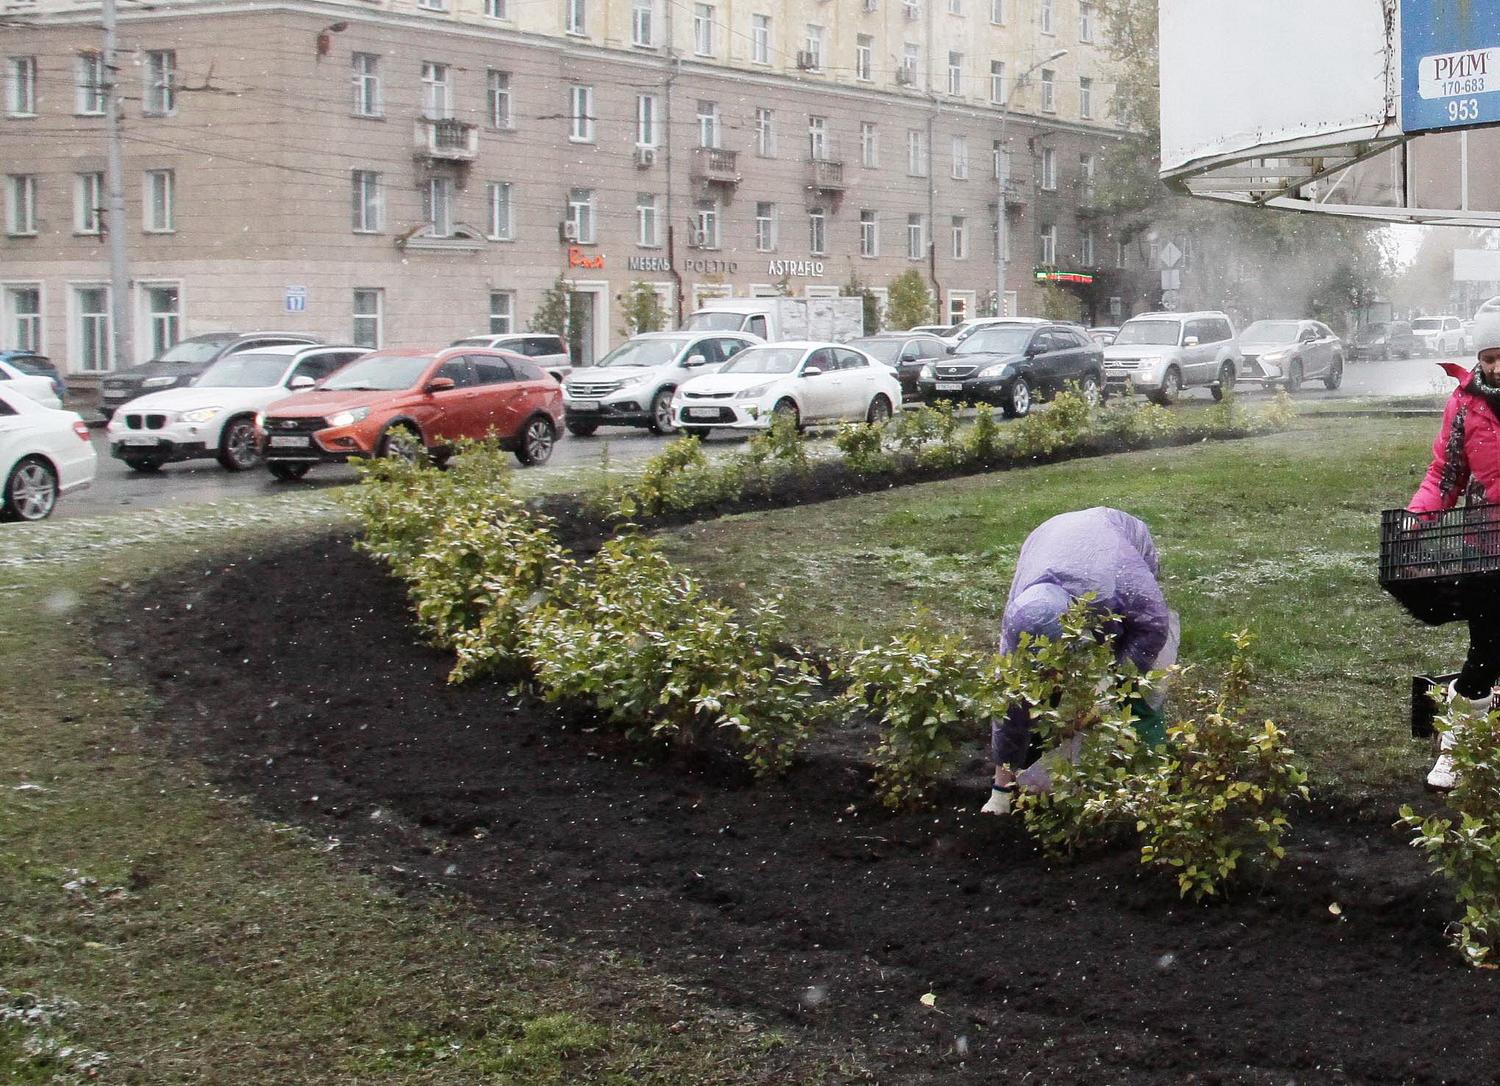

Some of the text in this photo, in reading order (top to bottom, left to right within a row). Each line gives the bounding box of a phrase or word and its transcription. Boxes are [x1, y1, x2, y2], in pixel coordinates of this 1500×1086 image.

[1442, 78, 1485, 95] 170-683
[1448, 98, 1479, 121] 953
[628, 256, 671, 271] МЕБЕЛЬ
[768, 260, 824, 276] ASTRAFLO
